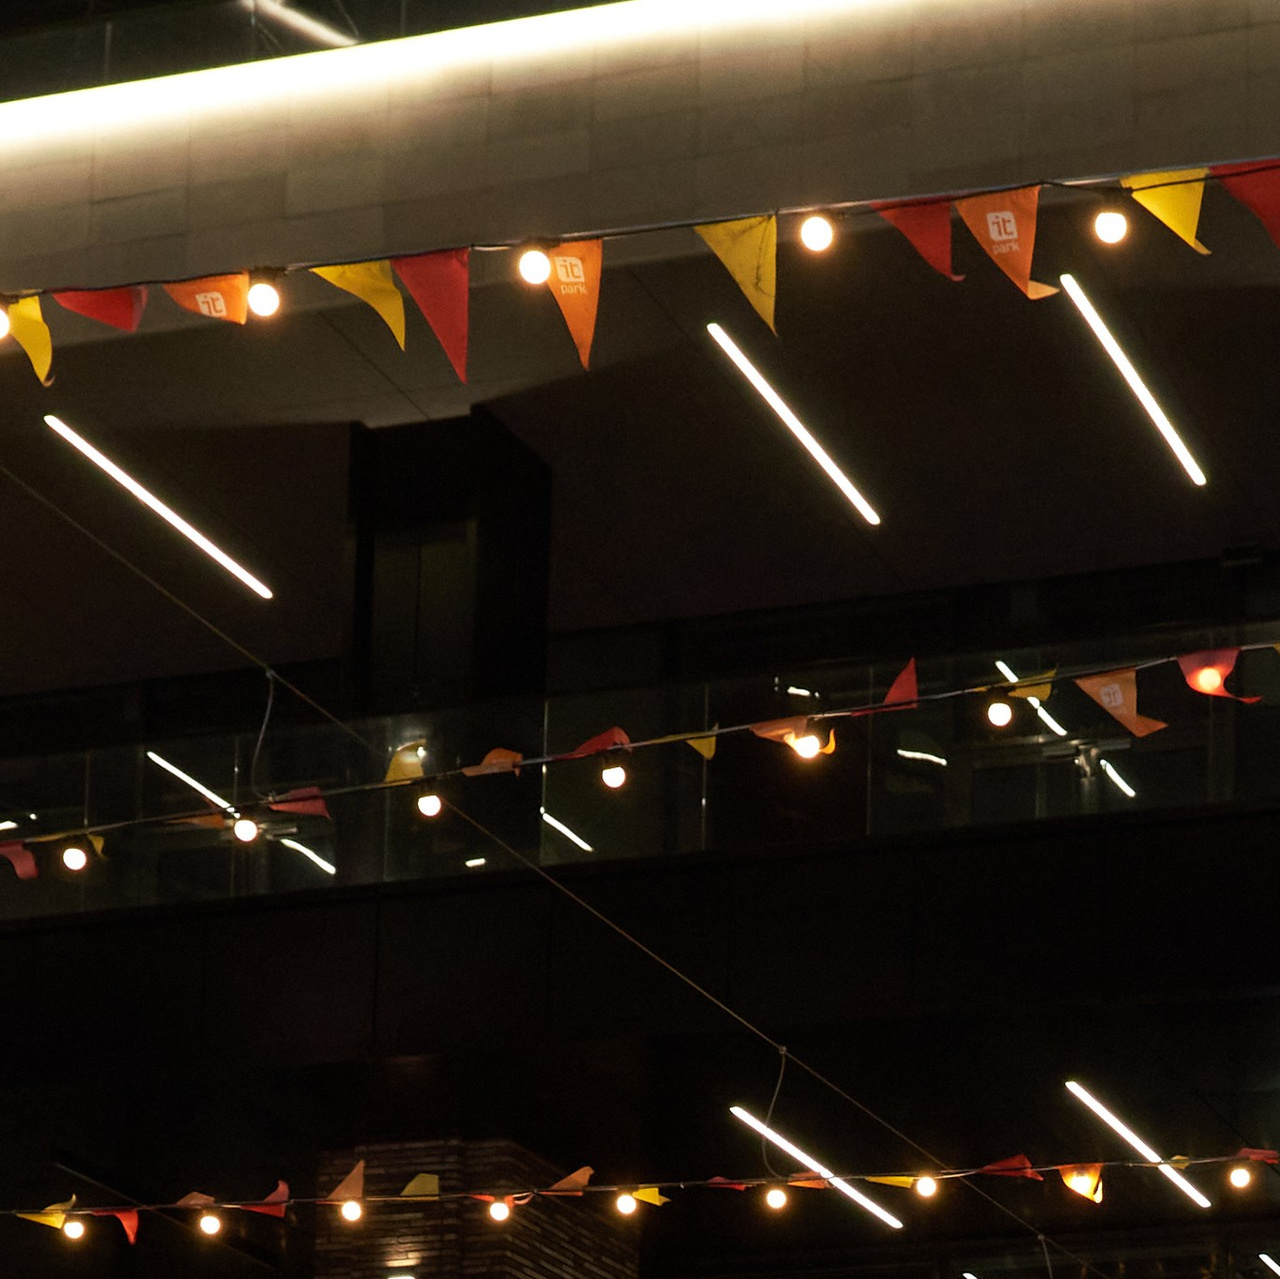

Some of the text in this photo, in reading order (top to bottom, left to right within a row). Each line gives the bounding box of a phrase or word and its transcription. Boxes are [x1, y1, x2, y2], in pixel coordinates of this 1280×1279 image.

[989, 213, 1015, 238] it
[992, 240, 1020, 255] park
[557, 258, 583, 280] it
[560, 283, 588, 296] park
[199, 293, 225, 316] it
